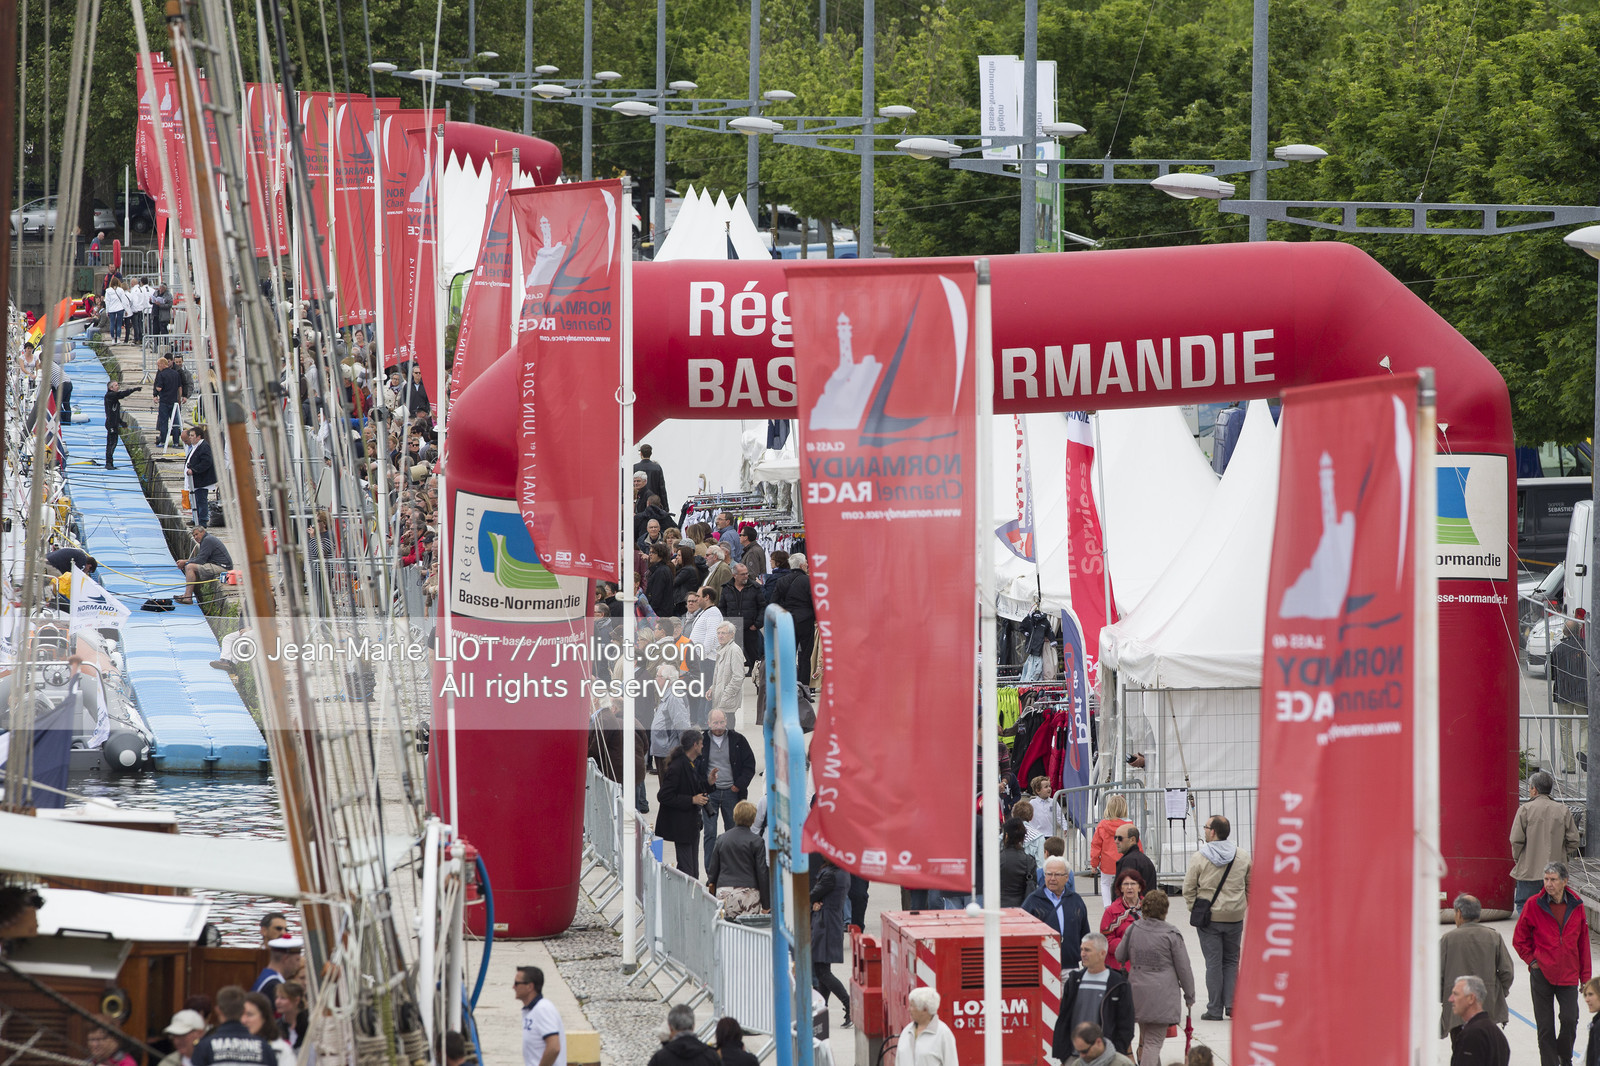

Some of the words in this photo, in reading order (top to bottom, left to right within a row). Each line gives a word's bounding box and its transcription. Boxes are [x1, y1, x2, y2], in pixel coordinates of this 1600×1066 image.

[689, 280, 794, 348] Rég
[688, 358, 797, 409] BAS
[1002, 328, 1275, 400] RMANDIE
[460, 507, 476, 583] Région
[1436, 553, 1501, 567] ormandie
[459, 588, 581, 611] Basse-Normandie
[953, 999, 1029, 1016] LOAM
[967, 1016, 1029, 1029] RETAL
